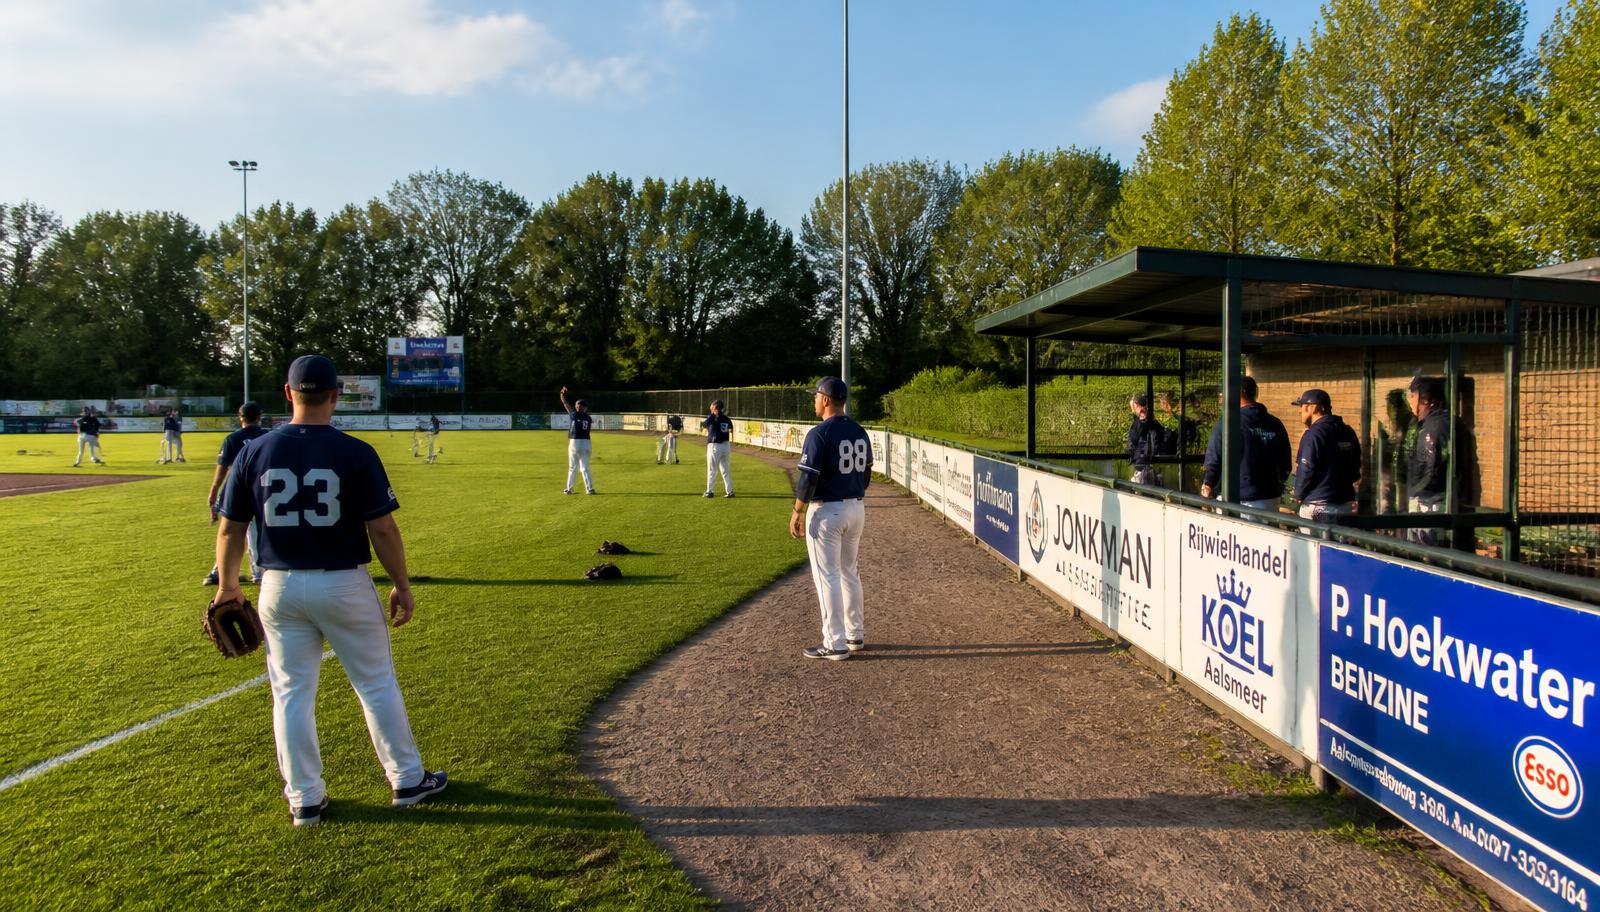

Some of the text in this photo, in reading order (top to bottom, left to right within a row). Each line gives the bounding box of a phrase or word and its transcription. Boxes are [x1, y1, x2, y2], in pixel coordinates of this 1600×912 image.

[838, 438, 868, 475] 88
[260, 468, 342, 527] 23
[1053, 503, 1152, 590] JONKMAN
[1188, 522, 1288, 580] Rijwielhandel
[1201, 594, 1274, 678] KOEL
[1331, 583, 1596, 729] P. Hoekwater
[1204, 656, 1268, 715] Aalsmeer
[1331, 653, 1430, 736] BENZINE
